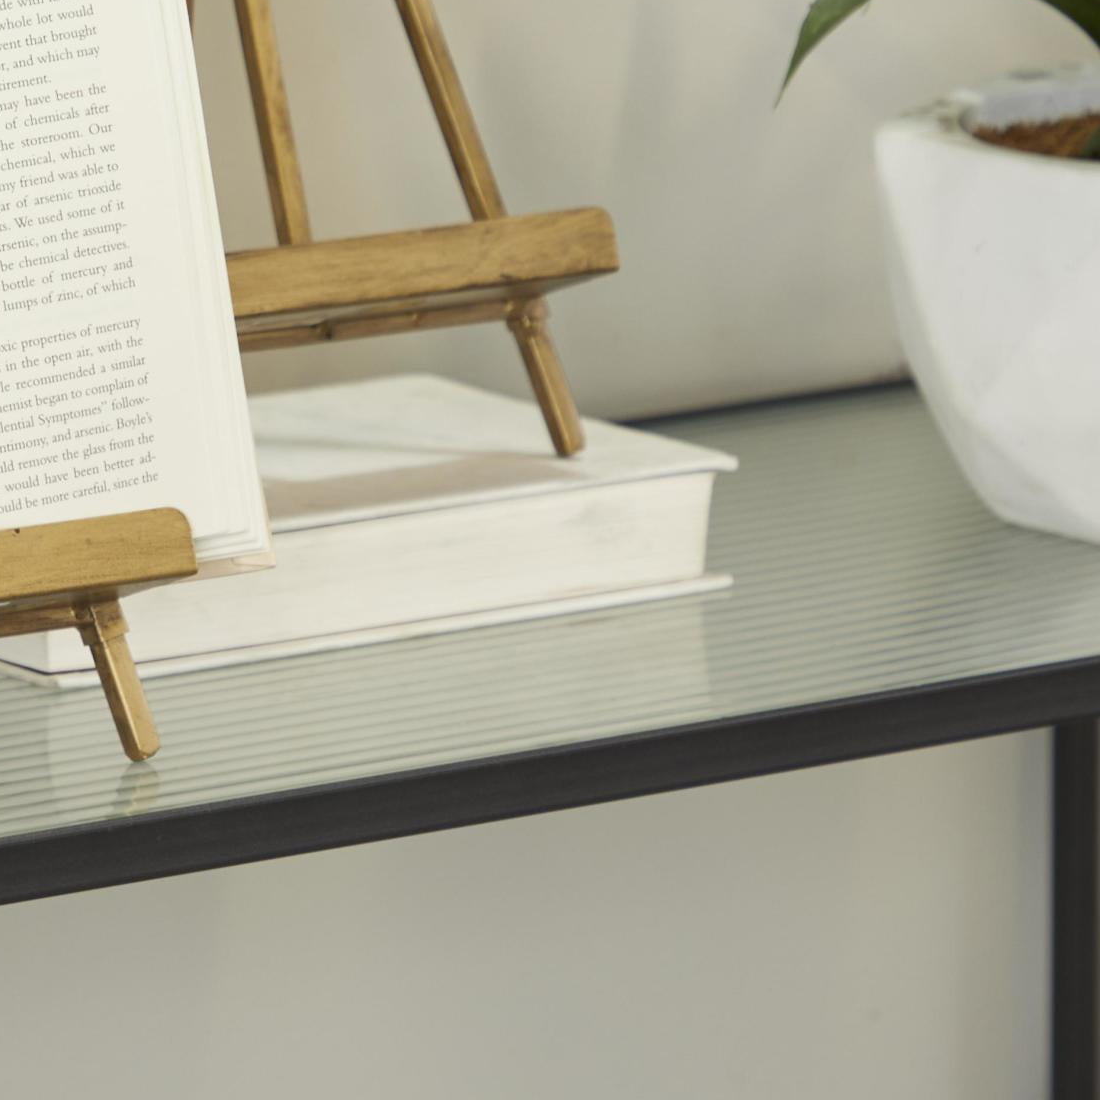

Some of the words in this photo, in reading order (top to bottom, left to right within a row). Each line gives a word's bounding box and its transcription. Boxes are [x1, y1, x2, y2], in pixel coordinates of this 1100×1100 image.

[4, 115, 19, 131] of
[23, 106, 80, 128] chemicals
[84, 102, 110, 117] after
[13, 215, 34, 229] We
[37, 208, 64, 226] used
[66, 206, 97, 221] some
[100, 199, 113, 214] of
[116, 200, 125, 211] it
[37, 400, 108, 427] Symptomes"
[111, 395, 150, 412] follow-
[51, 427, 72, 444] and
[74, 423, 114, 439] arsenic.
[115, 411, 153, 431] Boyle's
[17, 454, 59, 471] remove
[61, 448, 80, 461] the
[82, 443, 107, 461] glass
[108, 438, 135, 452] from
[137, 432, 155, 445] the
[4, 474, 41, 492] would
[43, 472, 69, 485] have
[72, 465, 100, 479] been
[103, 458, 135, 473] better
[139, 451, 156, 465] ad-
[24, 496, 39, 509] be
[40, 491, 70, 506] more
[72, 479, 111, 499] careful,
[112, 477, 140, 490] since
[141, 470, 159, 484] the
